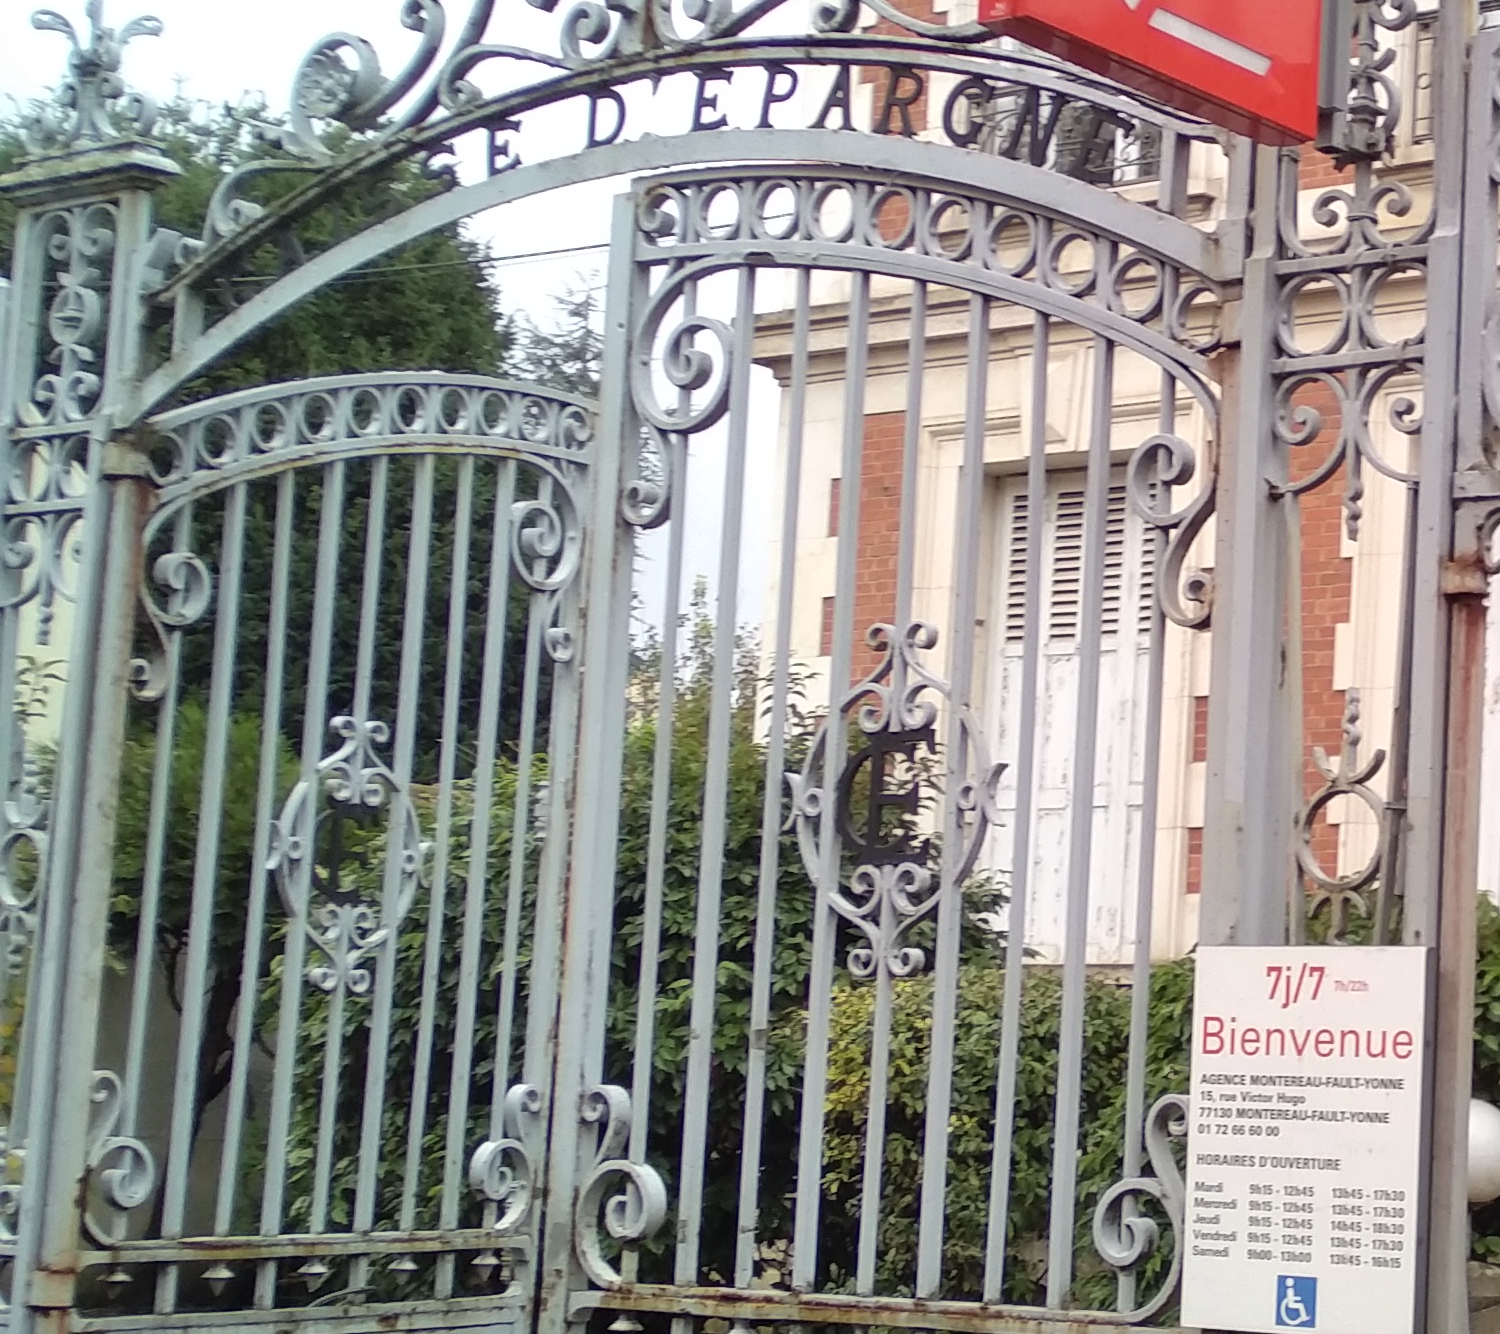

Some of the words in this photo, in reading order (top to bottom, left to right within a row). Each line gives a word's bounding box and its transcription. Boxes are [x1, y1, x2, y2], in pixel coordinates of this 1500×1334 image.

[1266, 963, 1325, 1009] 7j/7
[1202, 1017, 1413, 1059] Bienvenue
[1200, 1074, 1246, 1086] AGENCE
[1250, 1075, 1404, 1090] MONTEREAU-FAULT-YONNE
[1201, 1091, 1215, 1103] 15,
[1220, 1093, 1237, 1102] rue
[1241, 1092, 1273, 1103] Victor
[1277, 1093, 1305, 1106] Hugo
[1199, 1107, 1232, 1118] 77130
[1236, 1108, 1389, 1123] MONTEREAU-FAULT-YONNE
[1198, 1124, 1211, 1134] 01
[1215, 1125, 1228, 1135] 72
[1232, 1125, 1245, 1136] 66
[1249, 1126, 1262, 1136] 60
[1266, 1126, 1280, 1136] 00
[1197, 1154, 1256, 1167] HORAIRES
[1259, 1156, 1341, 1170] D'OUVERTURE
[1194, 1182, 1223, 1193] Mardi
[1249, 1184, 1273, 1195] 9h15
[1284, 1185, 1314, 1197] 12h45
[1332, 1188, 1363, 1199] 13h45
[1374, 1190, 1405, 1201] 17h30
[1194, 1198, 1237, 1209] Mercredi
[1249, 1200, 1273, 1211] 9h15
[1283, 1202, 1314, 1213] 12h45
[1332, 1205, 1363, 1216] 13h45
[1373, 1206, 1405, 1218] 17h30
[1193, 1214, 1220, 1226] Jeudi
[1249, 1216, 1272, 1227] 9h15
[1283, 1218, 1313, 1229] 12h45
[1192, 1230, 1237, 1242] Vendredi
[1248, 1232, 1271, 1244] 9h15
[1282, 1234, 1312, 1246] 12h45
[1330, 1237, 1361, 1249] 13h45
[1372, 1239, 1403, 1251] 17h30
[1192, 1246, 1229, 1257] Samedi
